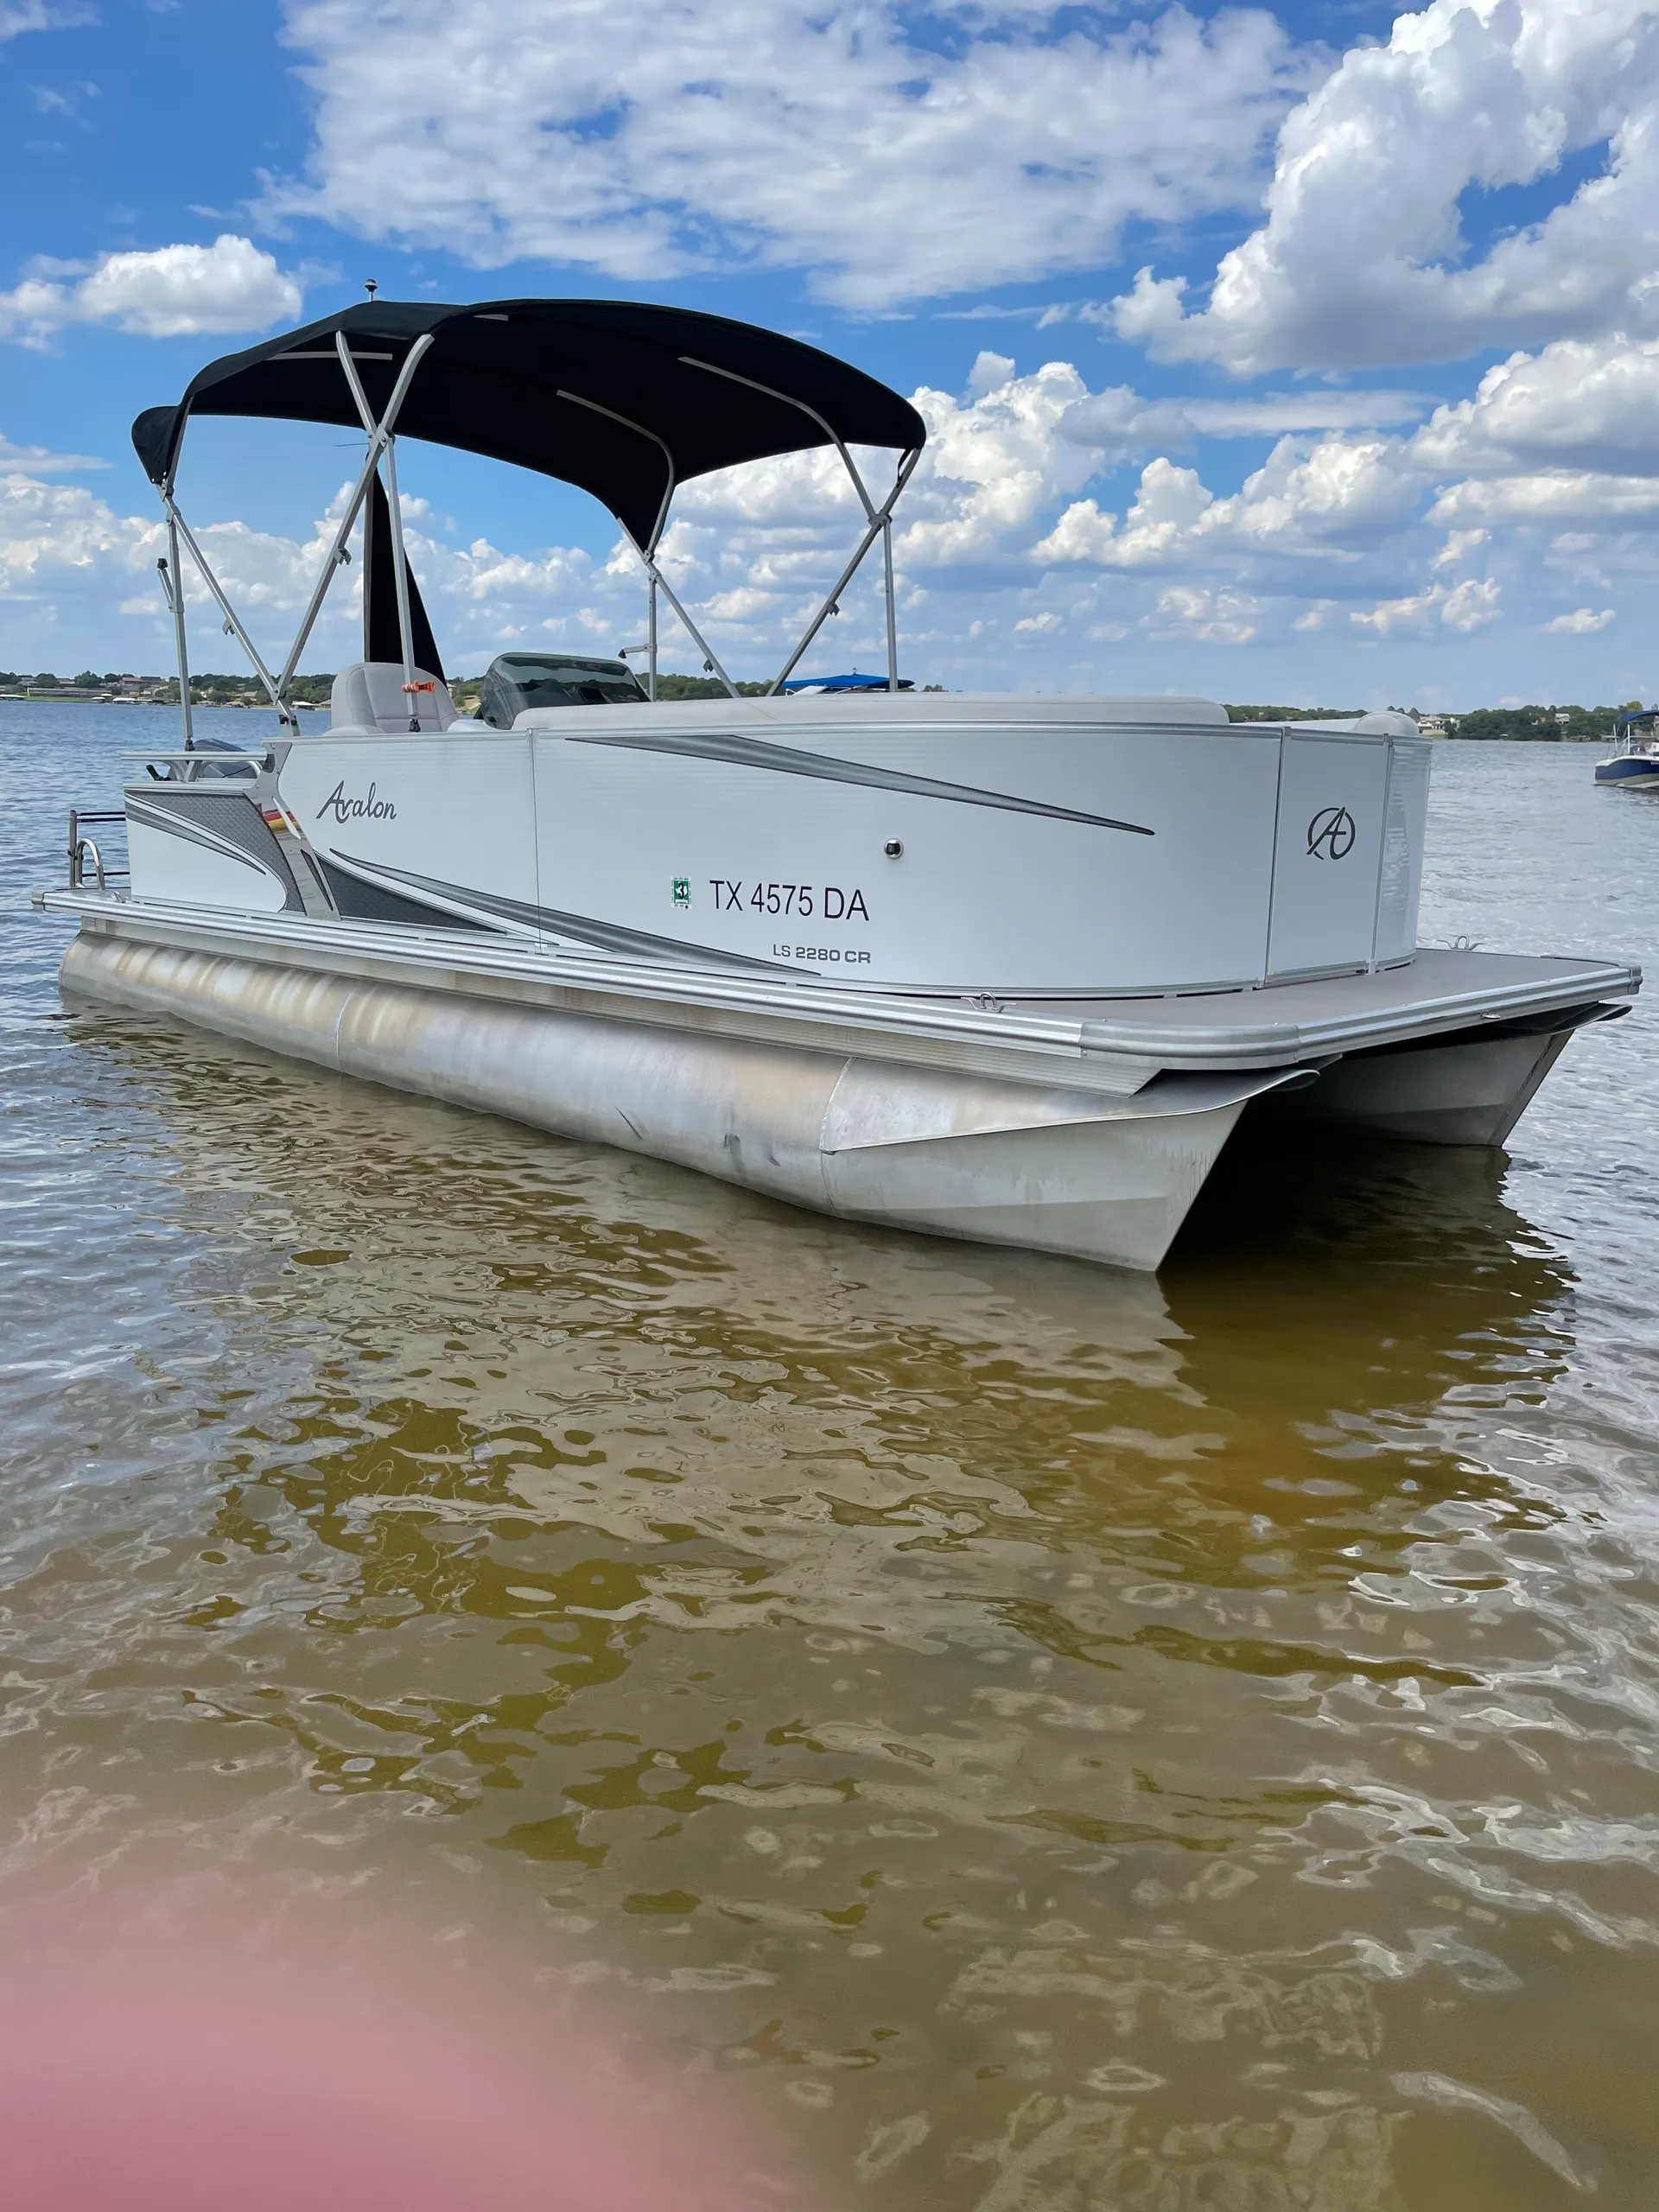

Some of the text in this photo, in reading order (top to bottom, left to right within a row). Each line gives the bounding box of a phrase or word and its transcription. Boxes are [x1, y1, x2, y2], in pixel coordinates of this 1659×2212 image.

[315, 779, 397, 824] Avalon
[677, 882, 685, 899] 3
[709, 880, 743, 911] TX
[750, 882, 814, 917] 4575
[823, 887, 870, 921] DA
[772, 944, 871, 964] LS 2280 CR
